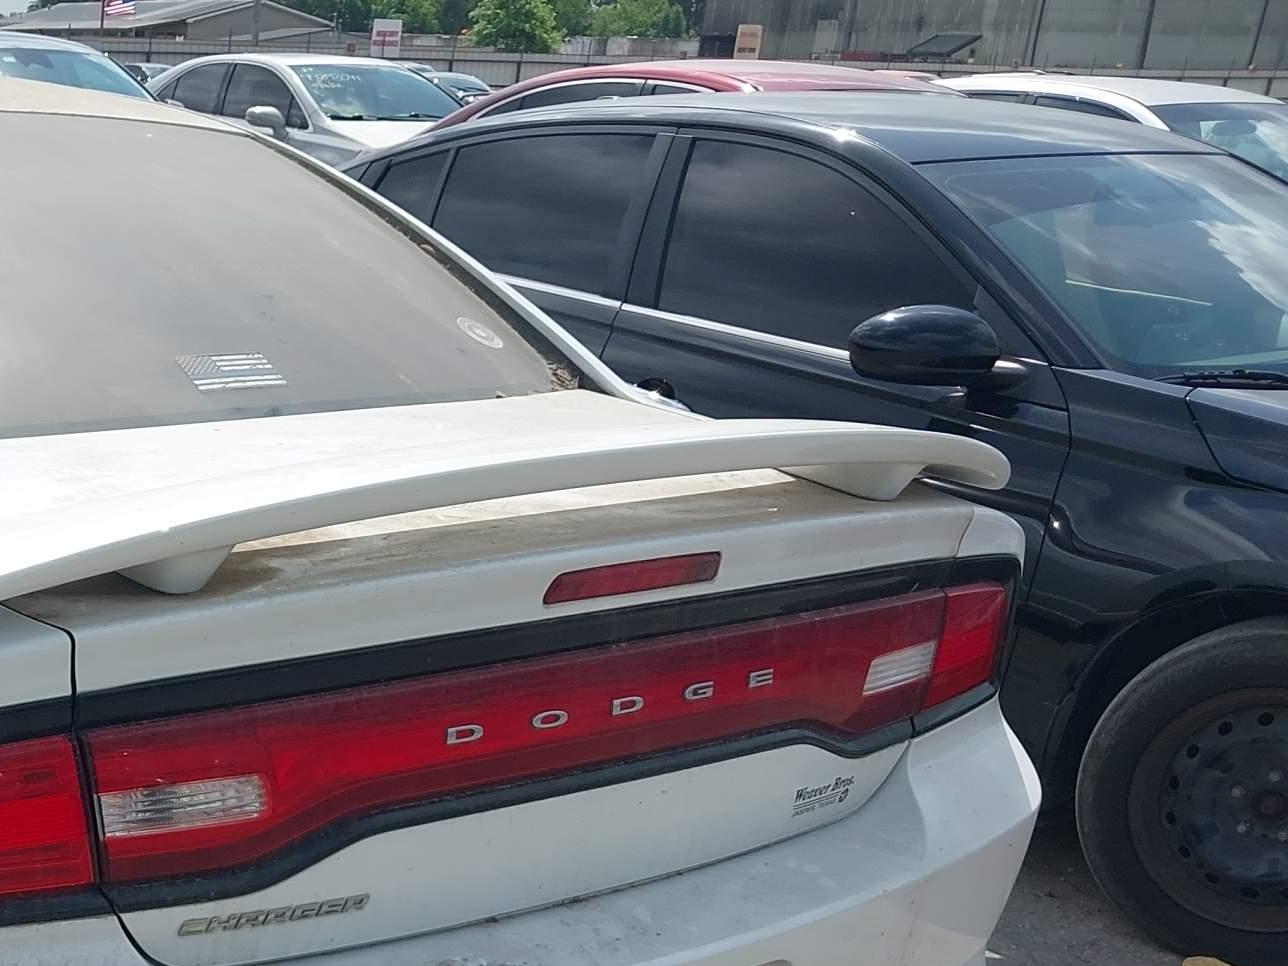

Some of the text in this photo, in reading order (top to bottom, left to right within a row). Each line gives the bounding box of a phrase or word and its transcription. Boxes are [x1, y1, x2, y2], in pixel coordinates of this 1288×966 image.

[446, 668, 774, 745] DODGE
[794, 775, 855, 802] Weaver Bros.
[177, 893, 371, 937] CHARGER
